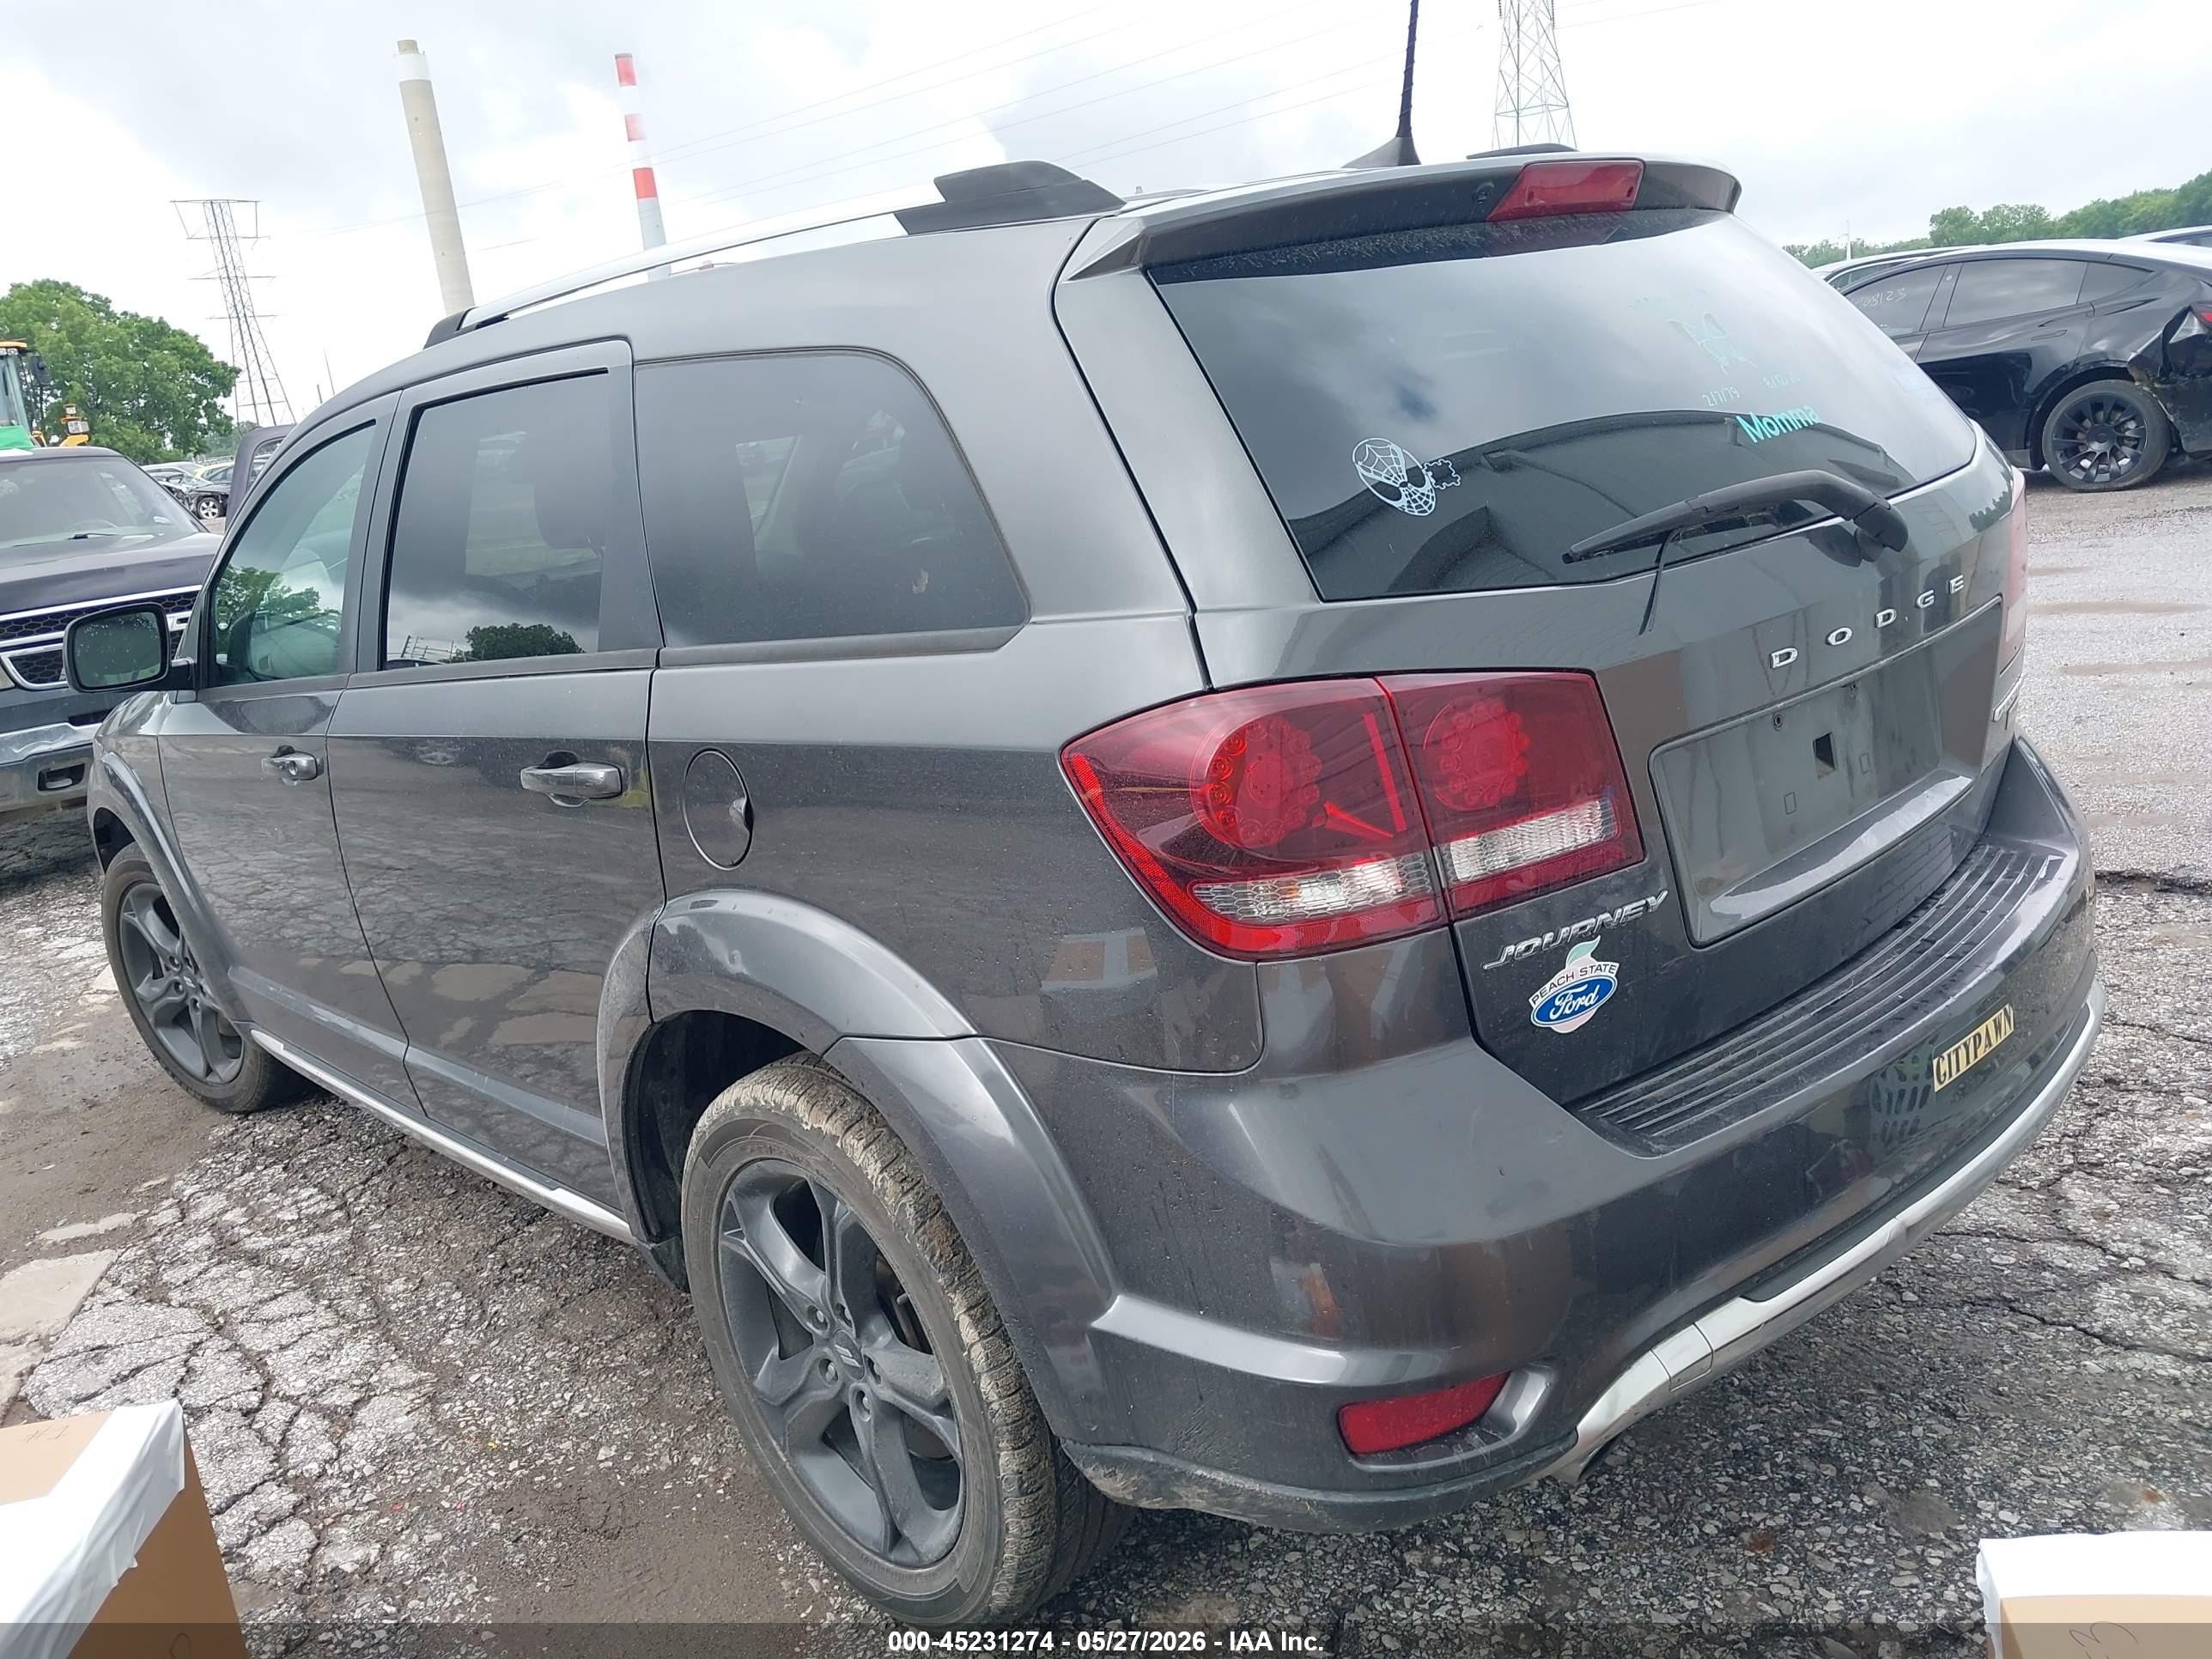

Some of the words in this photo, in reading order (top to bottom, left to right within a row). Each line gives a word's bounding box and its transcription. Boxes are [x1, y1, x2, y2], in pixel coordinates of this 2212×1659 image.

[1735, 404, 1821, 443] Momma
[1769, 574, 1965, 669] DODGE
[1481, 890, 1668, 970] JOURNEY
[1531, 971, 1575, 1006] PEACH
[1579, 963, 1617, 978] STATE
[1549, 983, 1601, 1020] Ford
